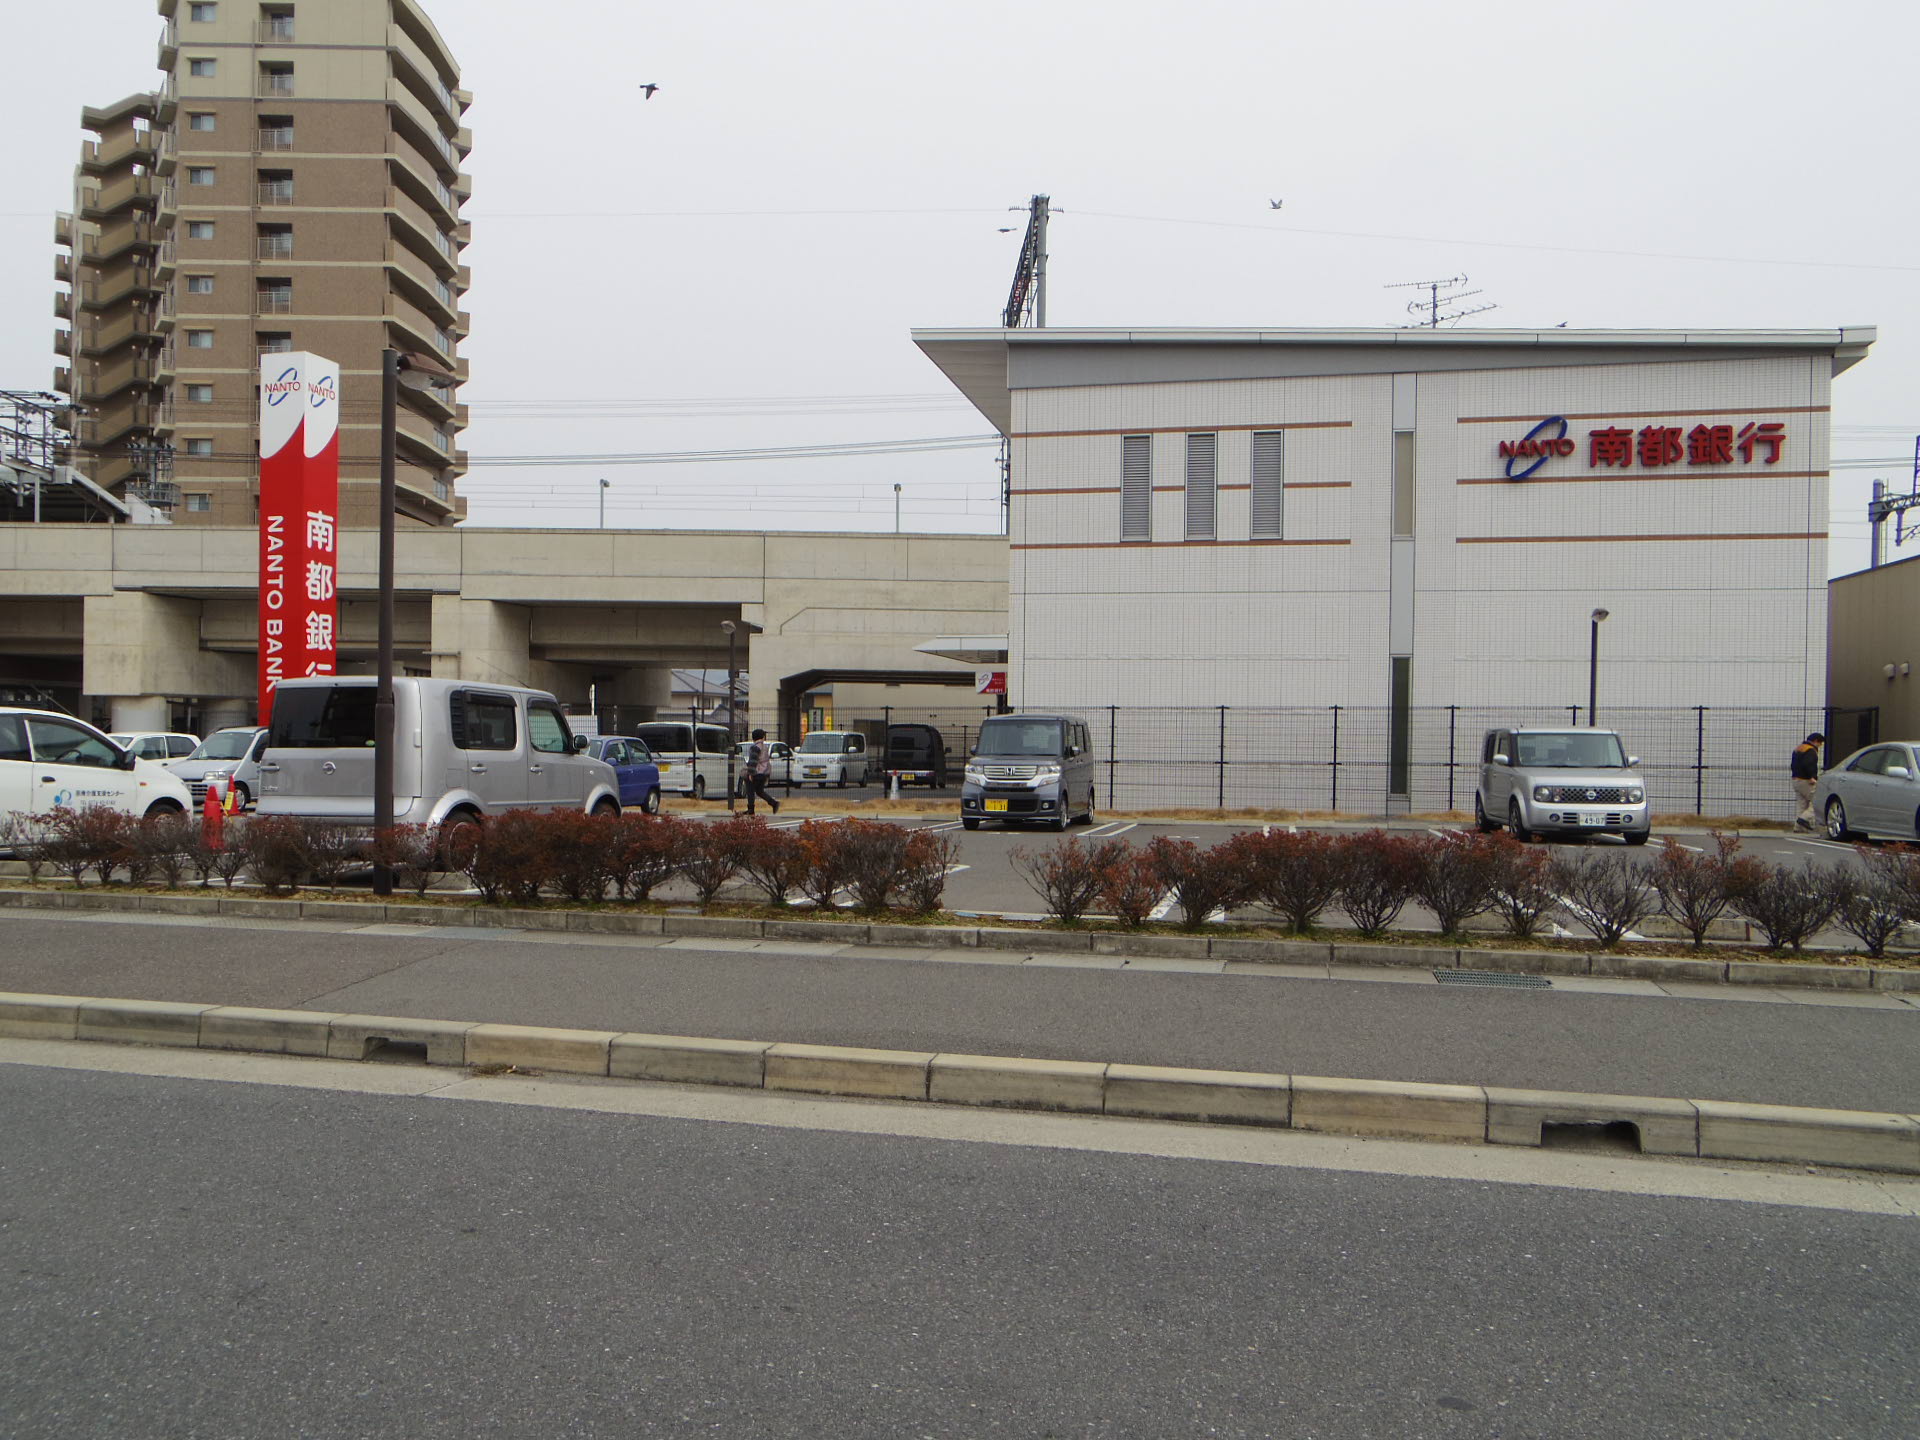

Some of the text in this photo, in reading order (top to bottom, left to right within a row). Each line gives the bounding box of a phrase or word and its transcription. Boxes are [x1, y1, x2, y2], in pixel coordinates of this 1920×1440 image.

[265, 381, 301, 394] NANTO
[308, 382, 336, 401] NANTO
[1499, 438, 1576, 458] NANTO
[1589, 421, 1787, 468] 南都銀行
[267, 515, 283, 610] NANTO
